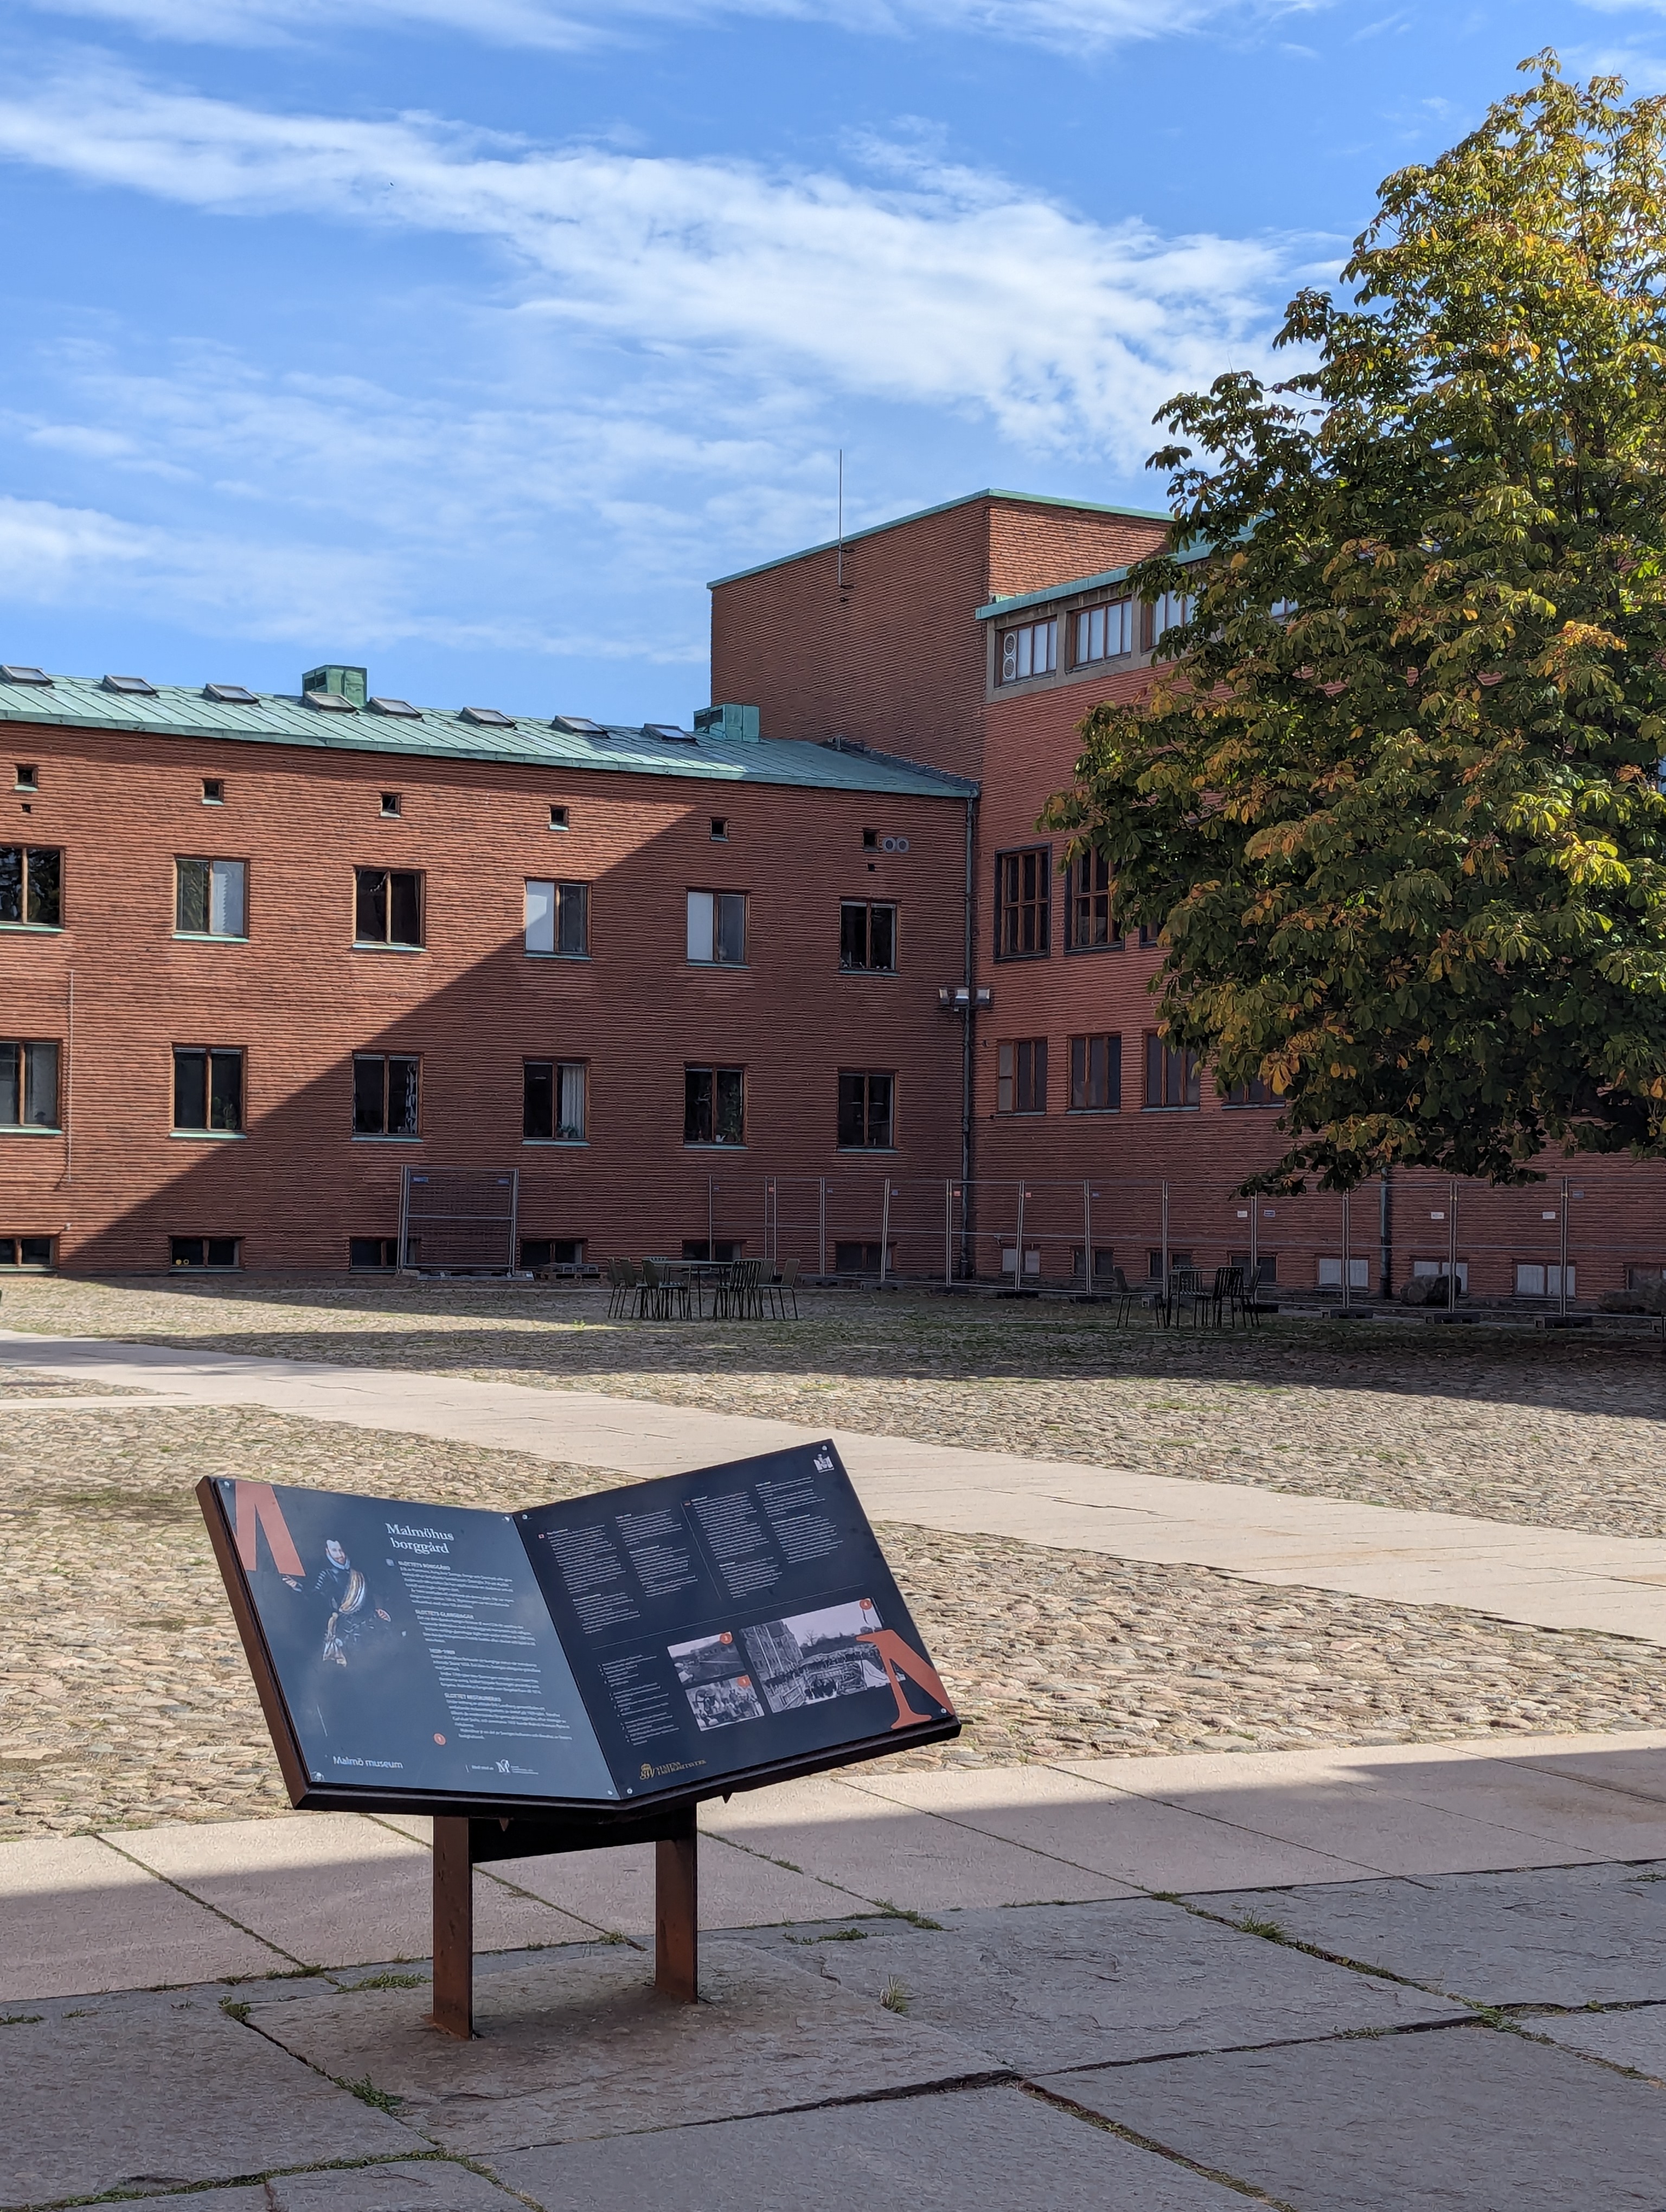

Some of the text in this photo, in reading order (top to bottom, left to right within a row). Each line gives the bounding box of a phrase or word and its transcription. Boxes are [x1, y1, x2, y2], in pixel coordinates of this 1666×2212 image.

[386, 1523, 454, 1541] Malmöhus
[390, 1537, 450, 1554] borggård
[333, 1756, 403, 1769] Malmö museum
